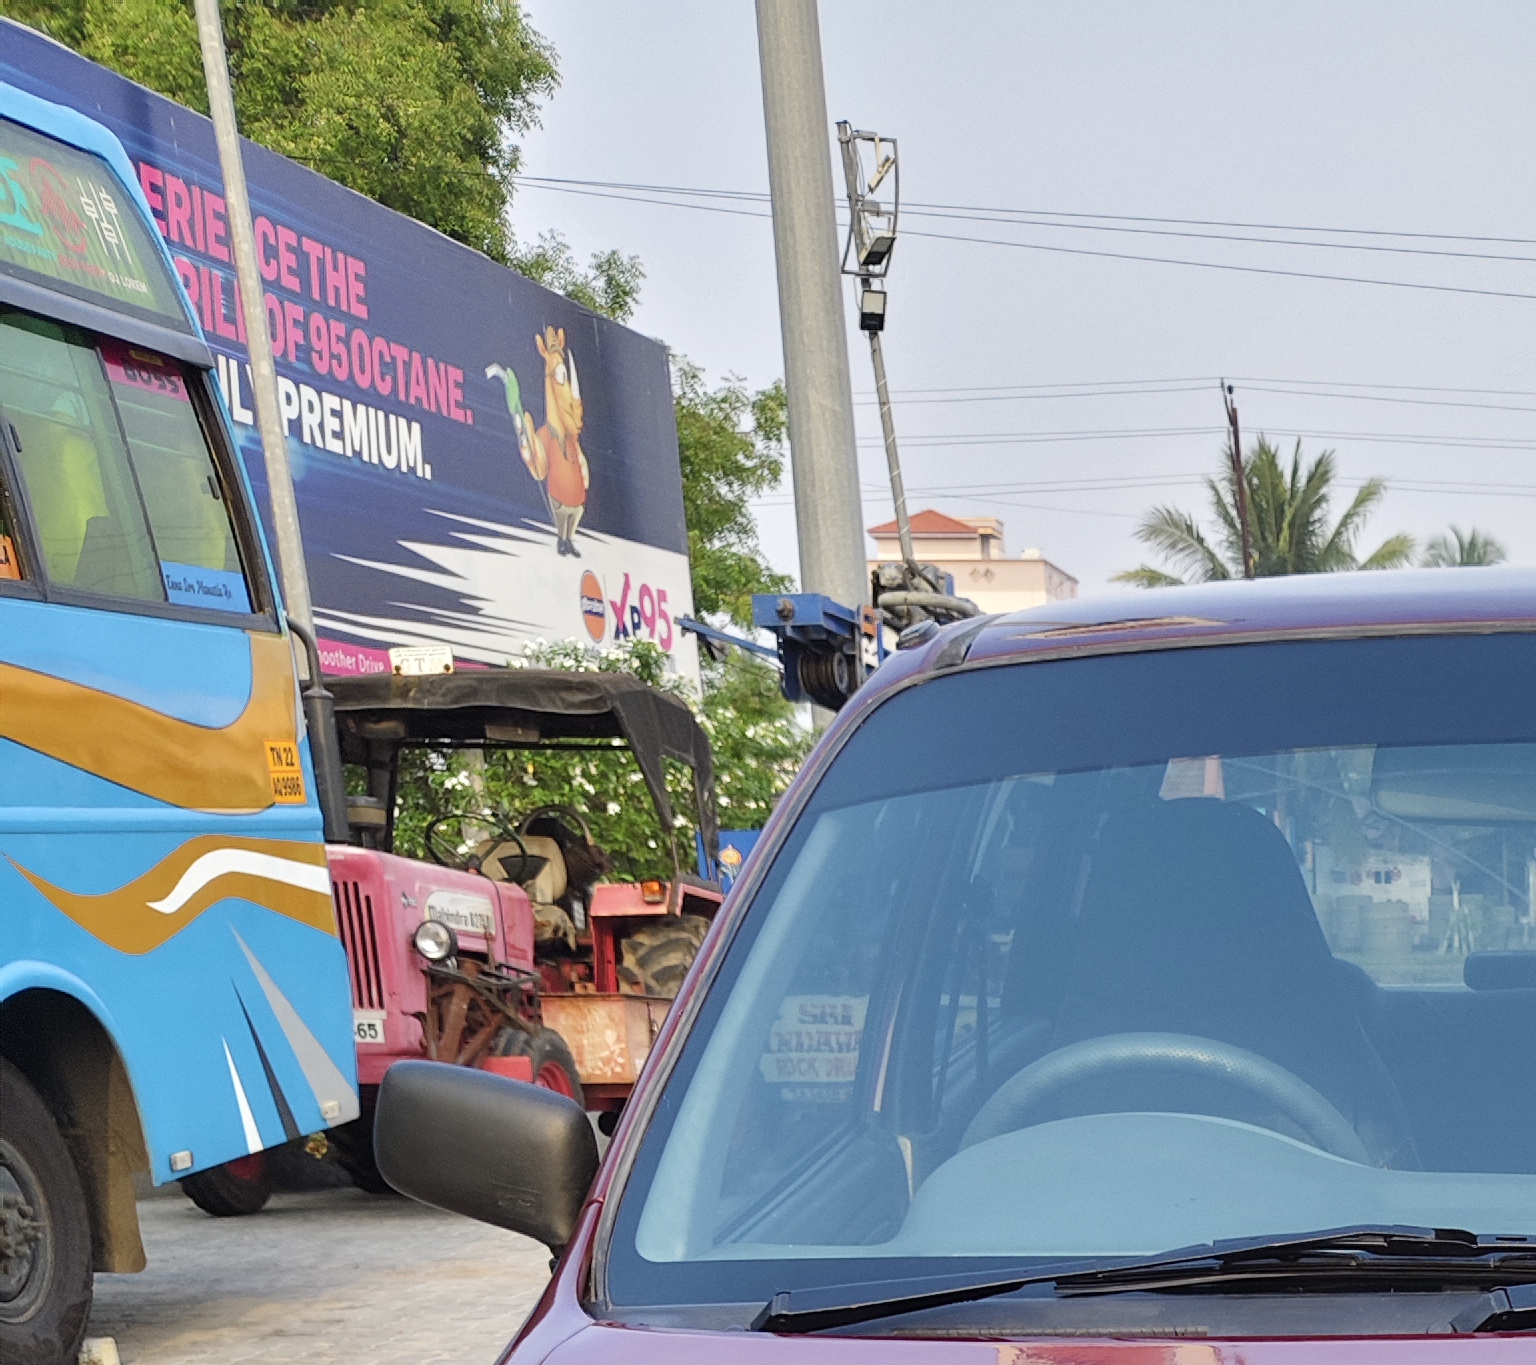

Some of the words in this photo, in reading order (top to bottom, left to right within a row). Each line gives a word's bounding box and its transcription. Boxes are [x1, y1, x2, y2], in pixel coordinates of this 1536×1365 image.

[302, 236, 369, 320] THE
[263, 292, 305, 363] OF
[309, 312, 350, 382] 95
[351, 328, 474, 425] OCTANE.
[276, 375, 432, 481] PREMIUM.
[358, 652, 385, 673] Drive
[270, 747, 283, 766] TN
[283, 747, 295, 767] 22
[428, 905, 468, 927] Mahindra
